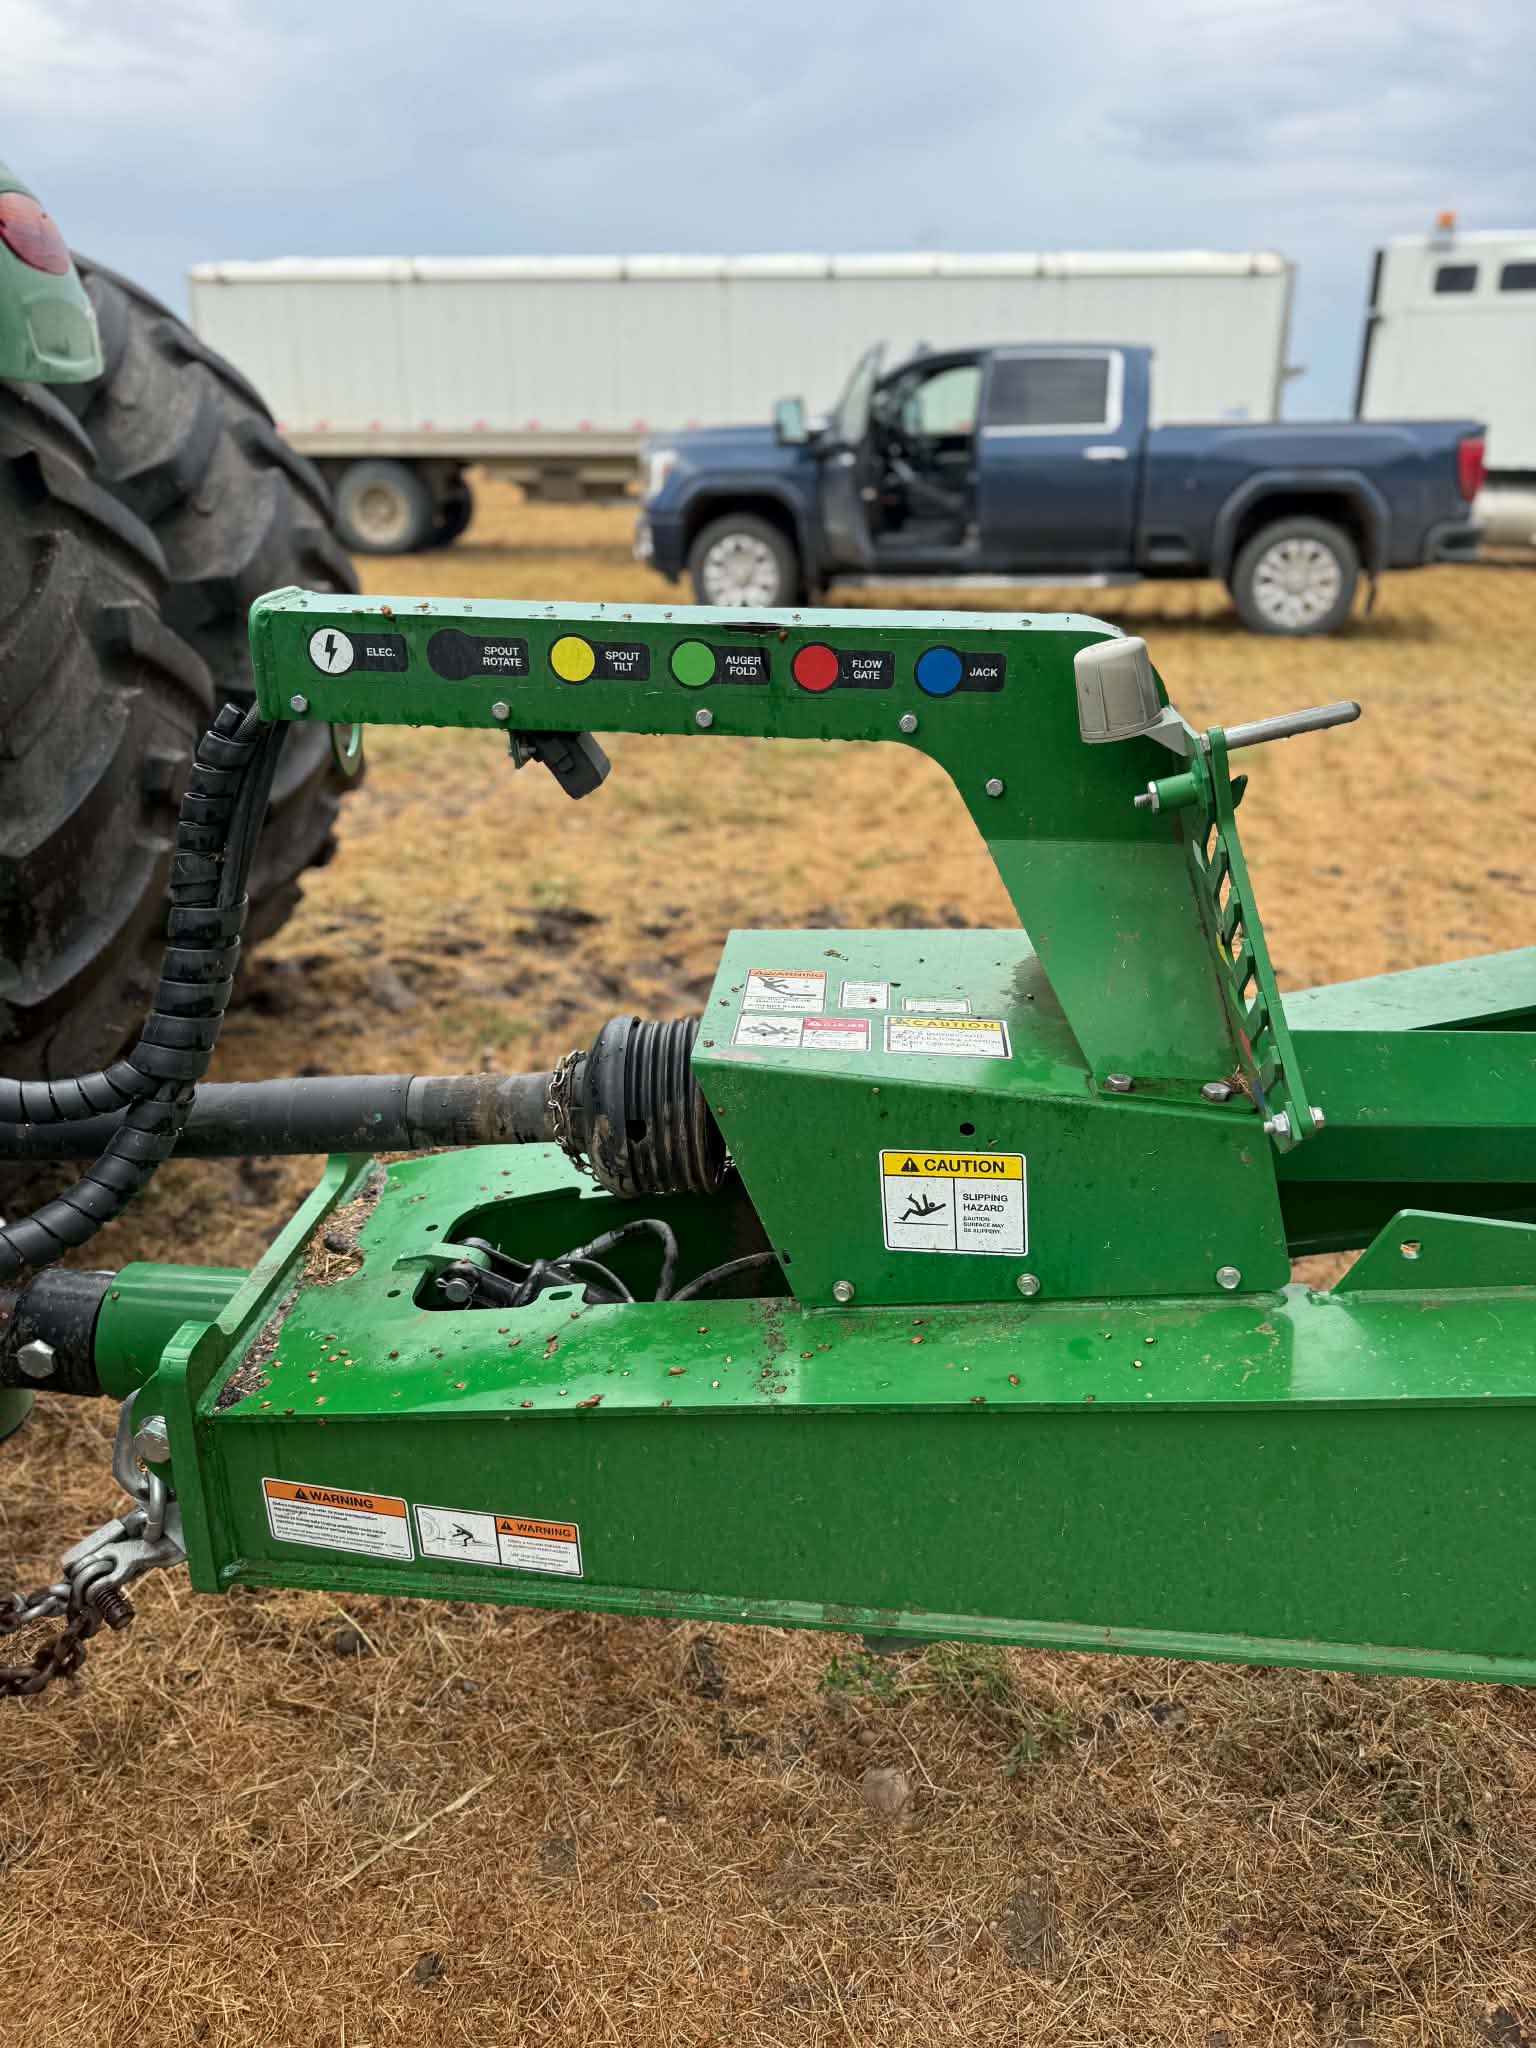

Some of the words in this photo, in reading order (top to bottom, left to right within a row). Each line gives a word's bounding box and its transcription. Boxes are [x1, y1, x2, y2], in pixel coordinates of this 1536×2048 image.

[366, 647, 396, 657] ELEC.
[484, 646, 519, 657] SPOUT
[605, 651, 640, 662] SPOUT
[483, 656, 523, 667] ROTATE
[725, 655, 761, 666] AUGER
[852, 659, 883, 669] FLOW
[613, 661, 634, 672] TILT
[730, 665, 757, 676] FOLD
[853, 669, 880, 680] GATE
[969, 667, 998, 678] JACK
[913, 1020, 994, 1029] CAUTION
[924, 1158, 1005, 1173] CAUTION
[962, 1193, 1008, 1202] SLIPPING
[963, 1203, 1005, 1212] HAZARD
[309, 1490, 374, 1509] WARNING
[516, 1523, 571, 1537] WARNING
